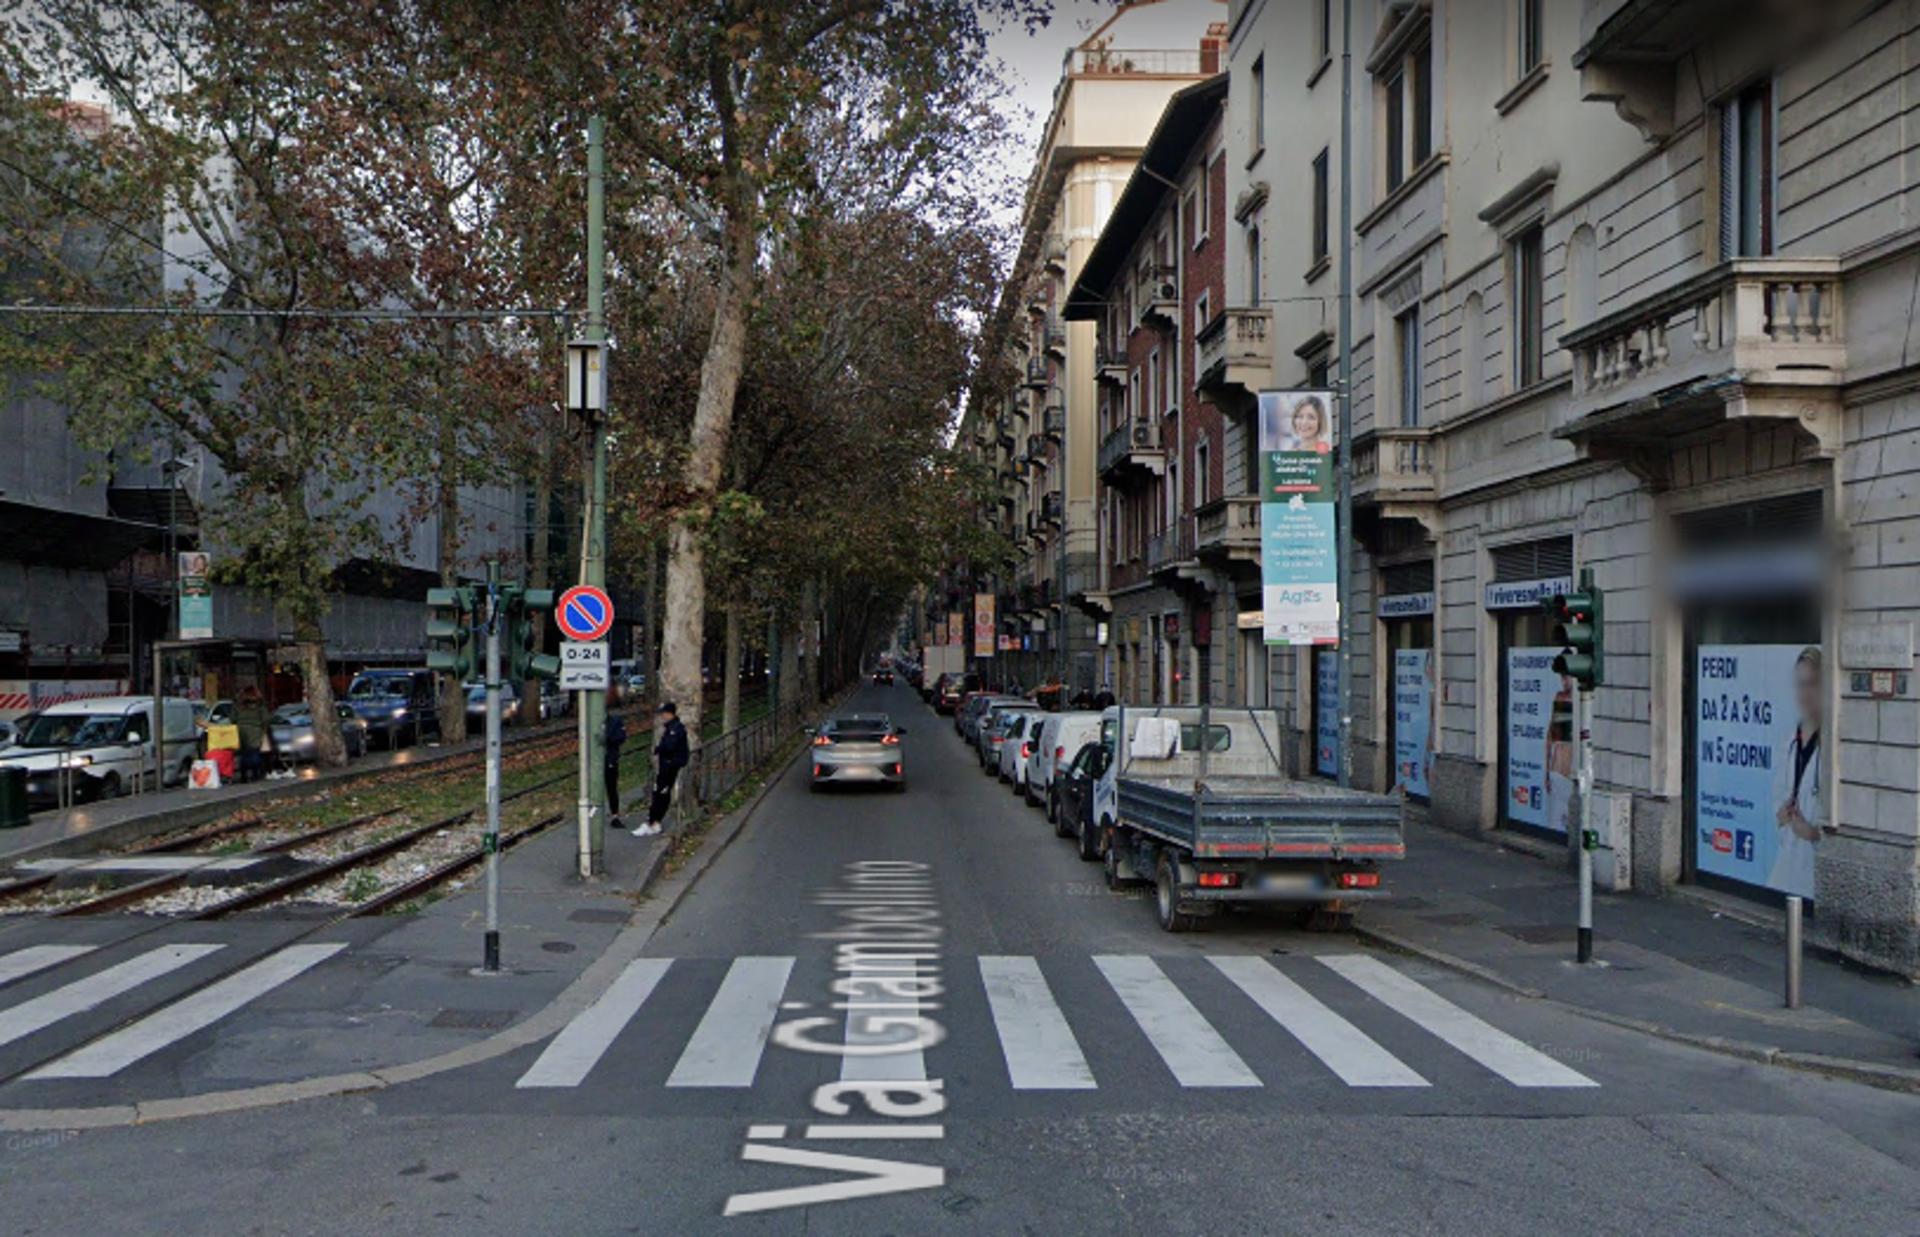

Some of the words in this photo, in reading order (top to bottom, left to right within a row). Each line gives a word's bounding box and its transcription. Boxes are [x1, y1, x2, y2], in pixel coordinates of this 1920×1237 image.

[1702, 656, 1737, 679] PERDI
[1702, 698, 1718, 720] DA
[1721, 693, 1729, 721] 2
[1731, 700, 1740, 723] A
[1742, 693, 1750, 724] 3
[1753, 700, 1772, 726] KG
[1702, 740, 1714, 763] IN
[1716, 735, 1724, 763] 5
[1726, 742, 1772, 770] GIORNI
